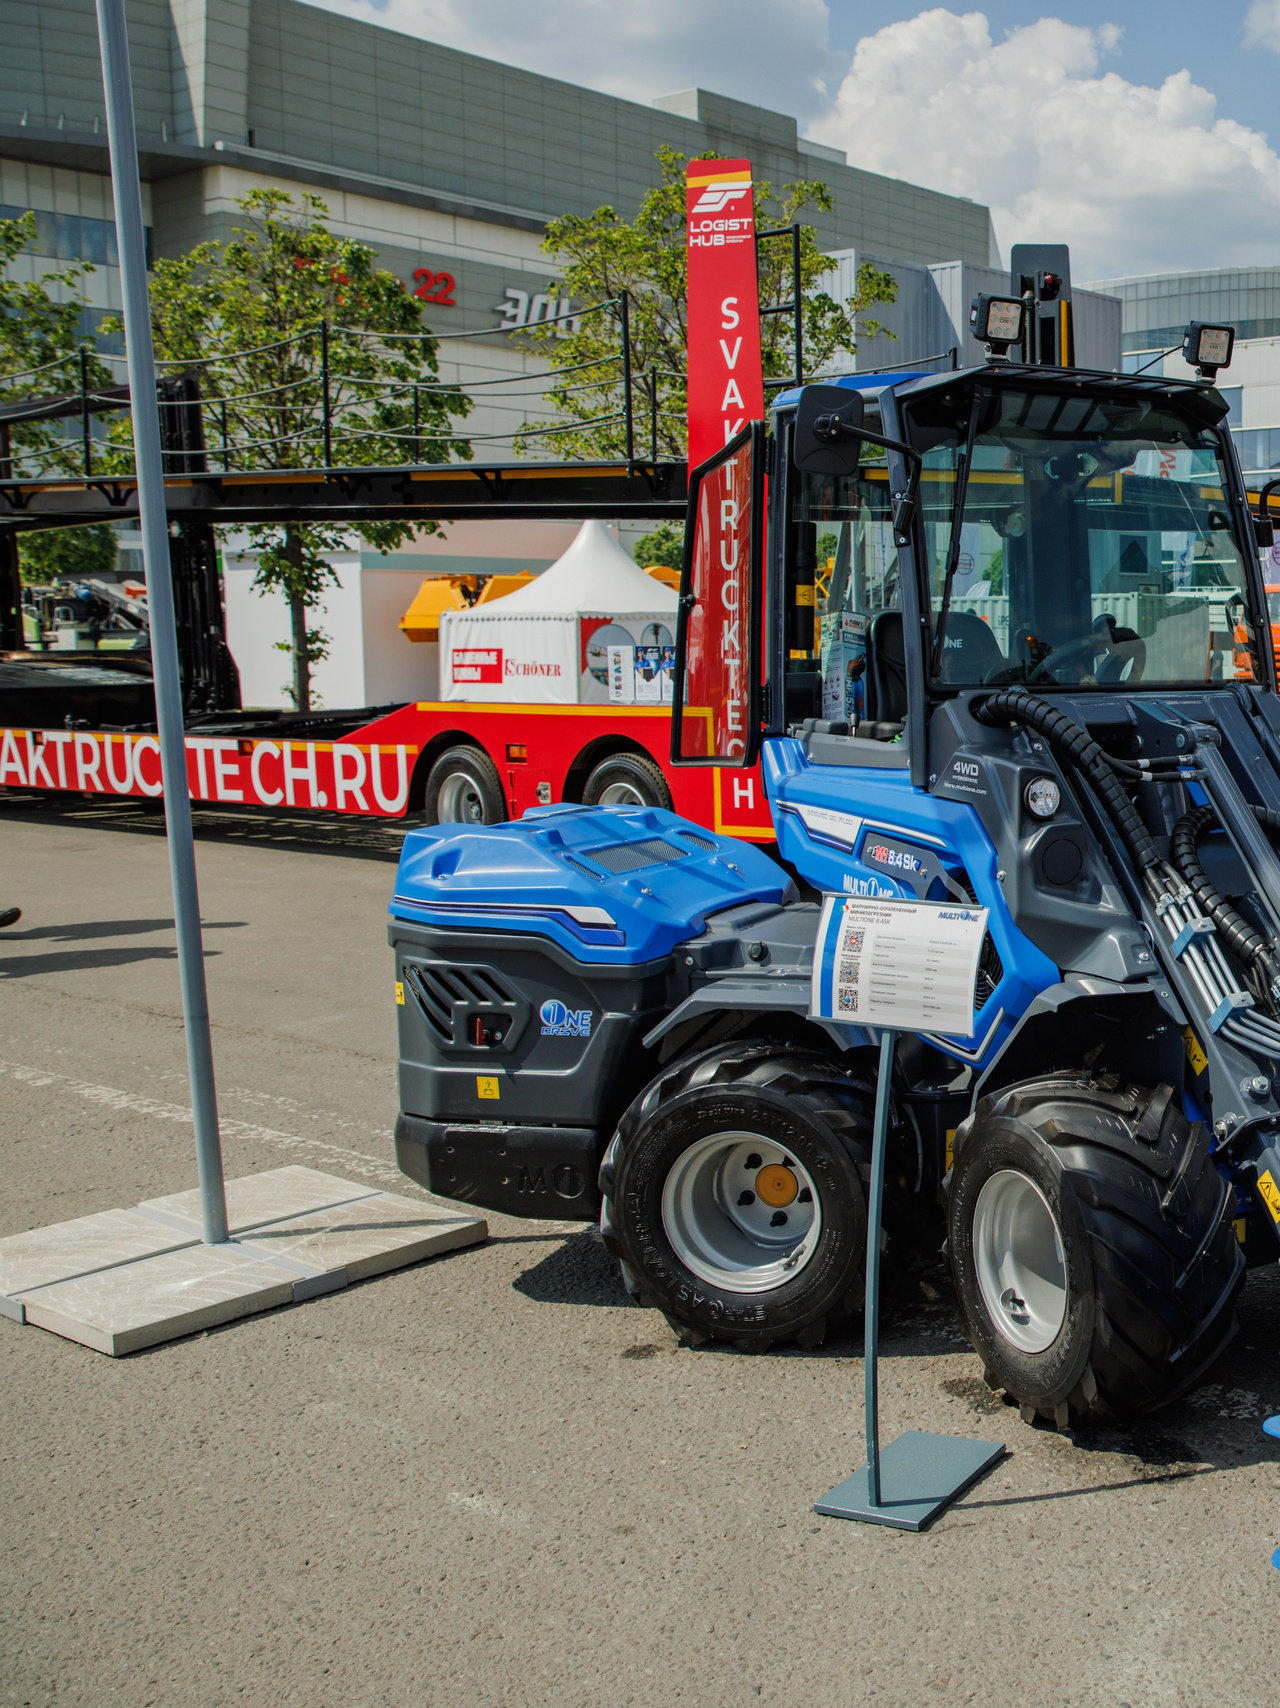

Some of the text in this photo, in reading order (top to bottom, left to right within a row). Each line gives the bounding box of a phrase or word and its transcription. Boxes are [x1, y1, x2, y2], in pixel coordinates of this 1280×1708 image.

[690, 219, 752, 233] LOGIST
[690, 234, 725, 246] HUB
[414, 268, 456, 305] 22
[953, 761, 979, 776] 4WD
[944, 782, 987, 795] www.multione.com
[851, 904, 917, 913] ШАРНИРНО-СОЧЛЕНЕННЫЙ
[848, 916, 875, 924] MULTIONE
[938, 911, 981, 922] MULTIONE
[541, 1026, 591, 1036] DRIVE
